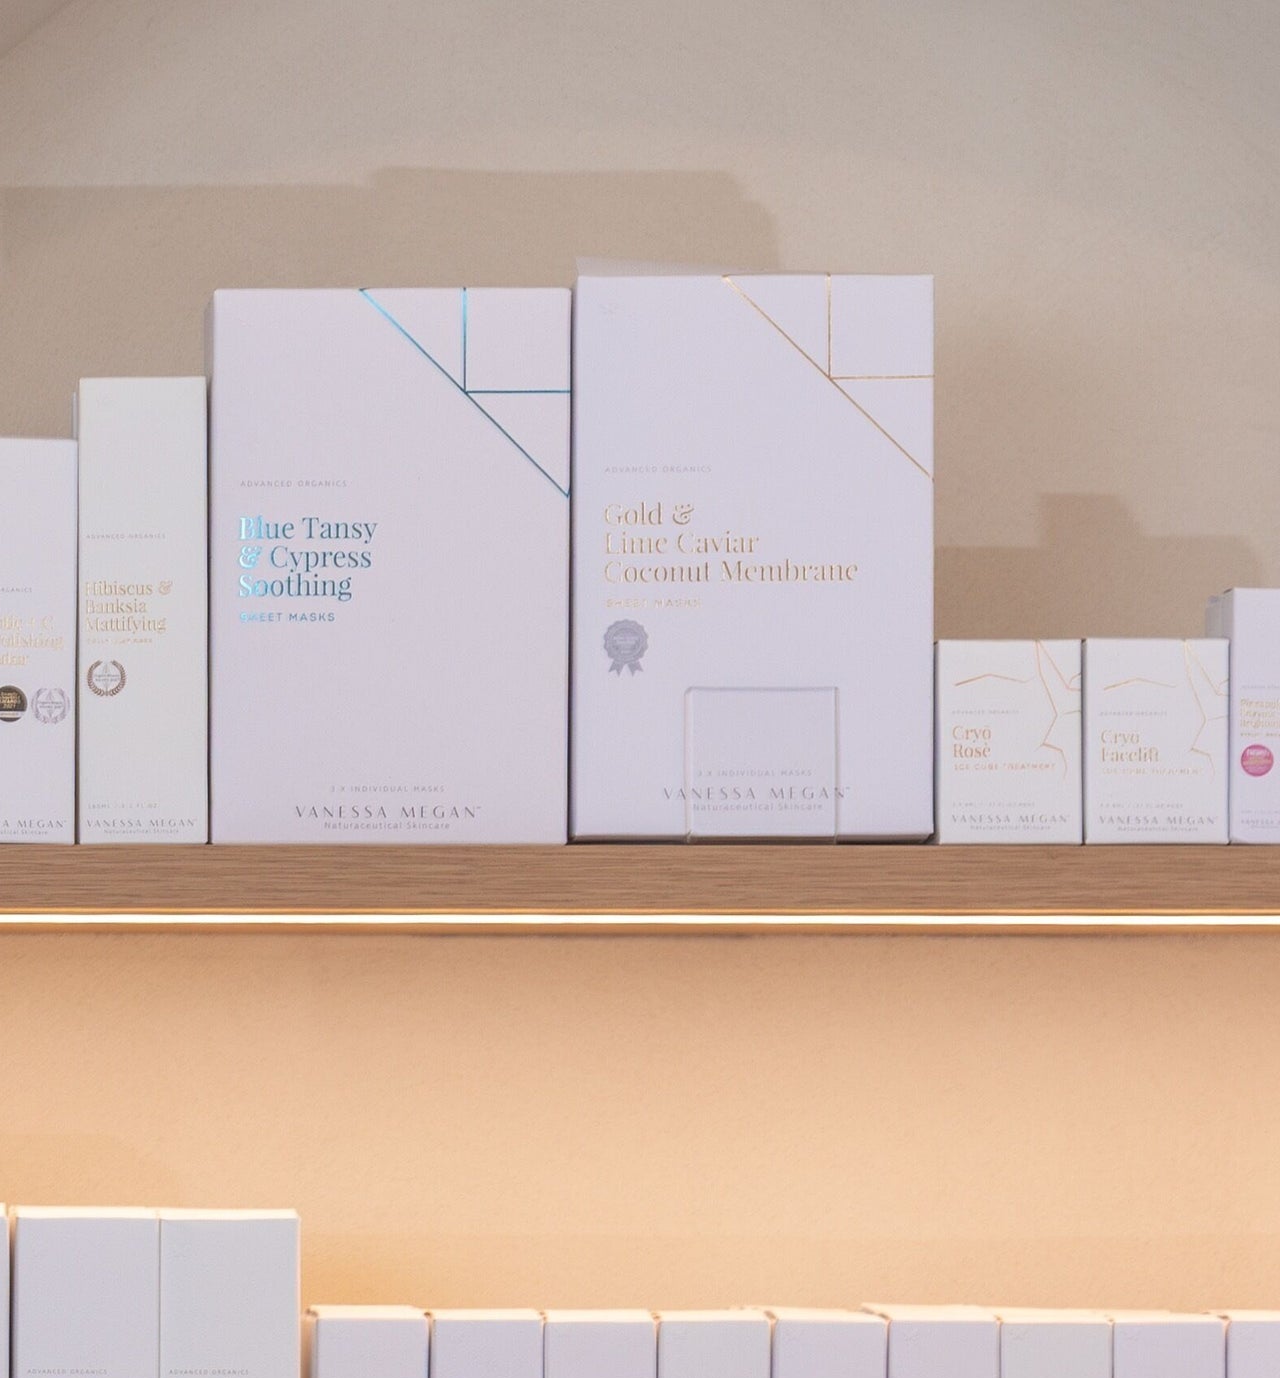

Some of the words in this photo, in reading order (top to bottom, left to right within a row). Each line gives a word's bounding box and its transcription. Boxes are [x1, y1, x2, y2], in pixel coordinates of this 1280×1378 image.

[604, 502, 663, 525] Gold
[673, 504, 695, 525] &
[239, 516, 294, 540] Blue
[302, 517, 377, 544] Tansy
[605, 532, 667, 555] Lime
[677, 531, 759, 554] Caviar
[239, 546, 263, 569] &
[270, 545, 372, 572] Cypress
[604, 561, 710, 584] Coconut
[720, 559, 858, 582] Membrane
[238, 573, 352, 602] Soothing
[289, 612, 335, 622] MASKS
[296, 805, 387, 819] VANESSA
